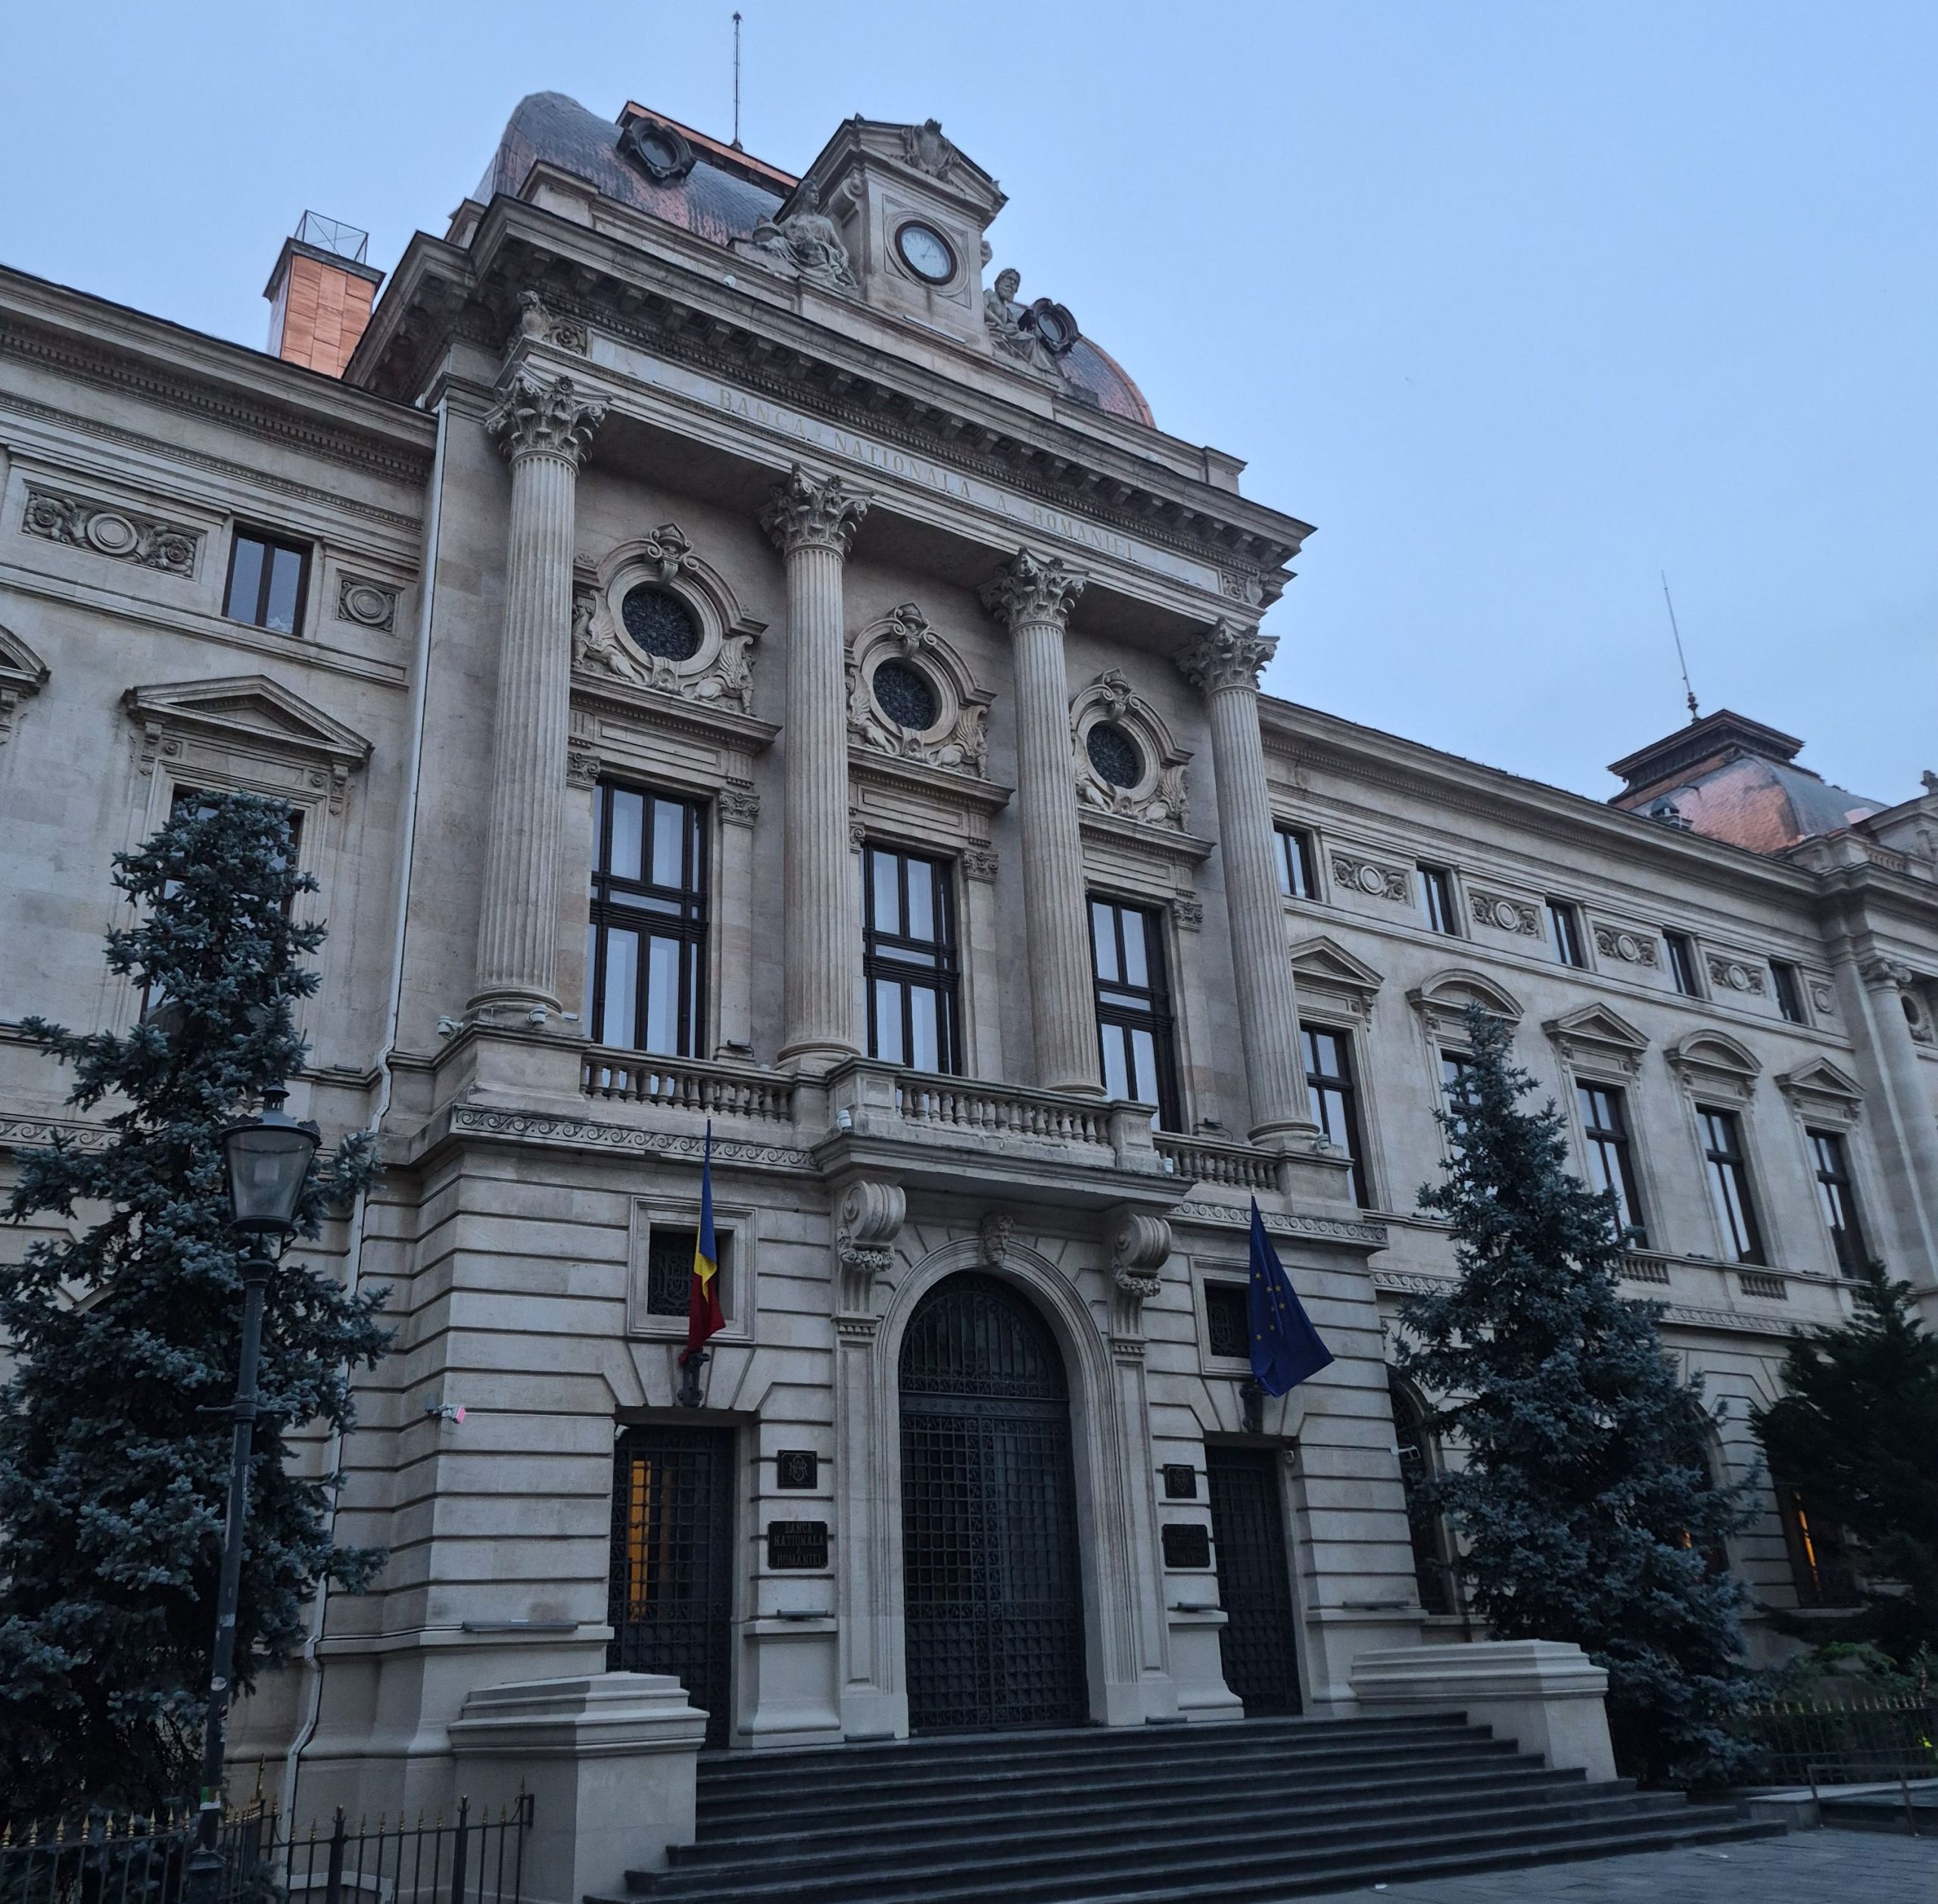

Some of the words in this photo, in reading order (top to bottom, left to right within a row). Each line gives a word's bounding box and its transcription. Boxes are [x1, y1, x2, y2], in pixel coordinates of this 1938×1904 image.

[718, 388, 805, 437] BANCA
[834, 432, 971, 498] NATIONALA
[997, 494, 1008, 512] A
[1032, 506, 1133, 559] ROMANIEI
[784, 1522, 813, 1534] BANCA
[774, 1535, 824, 1547] NATIONALA
